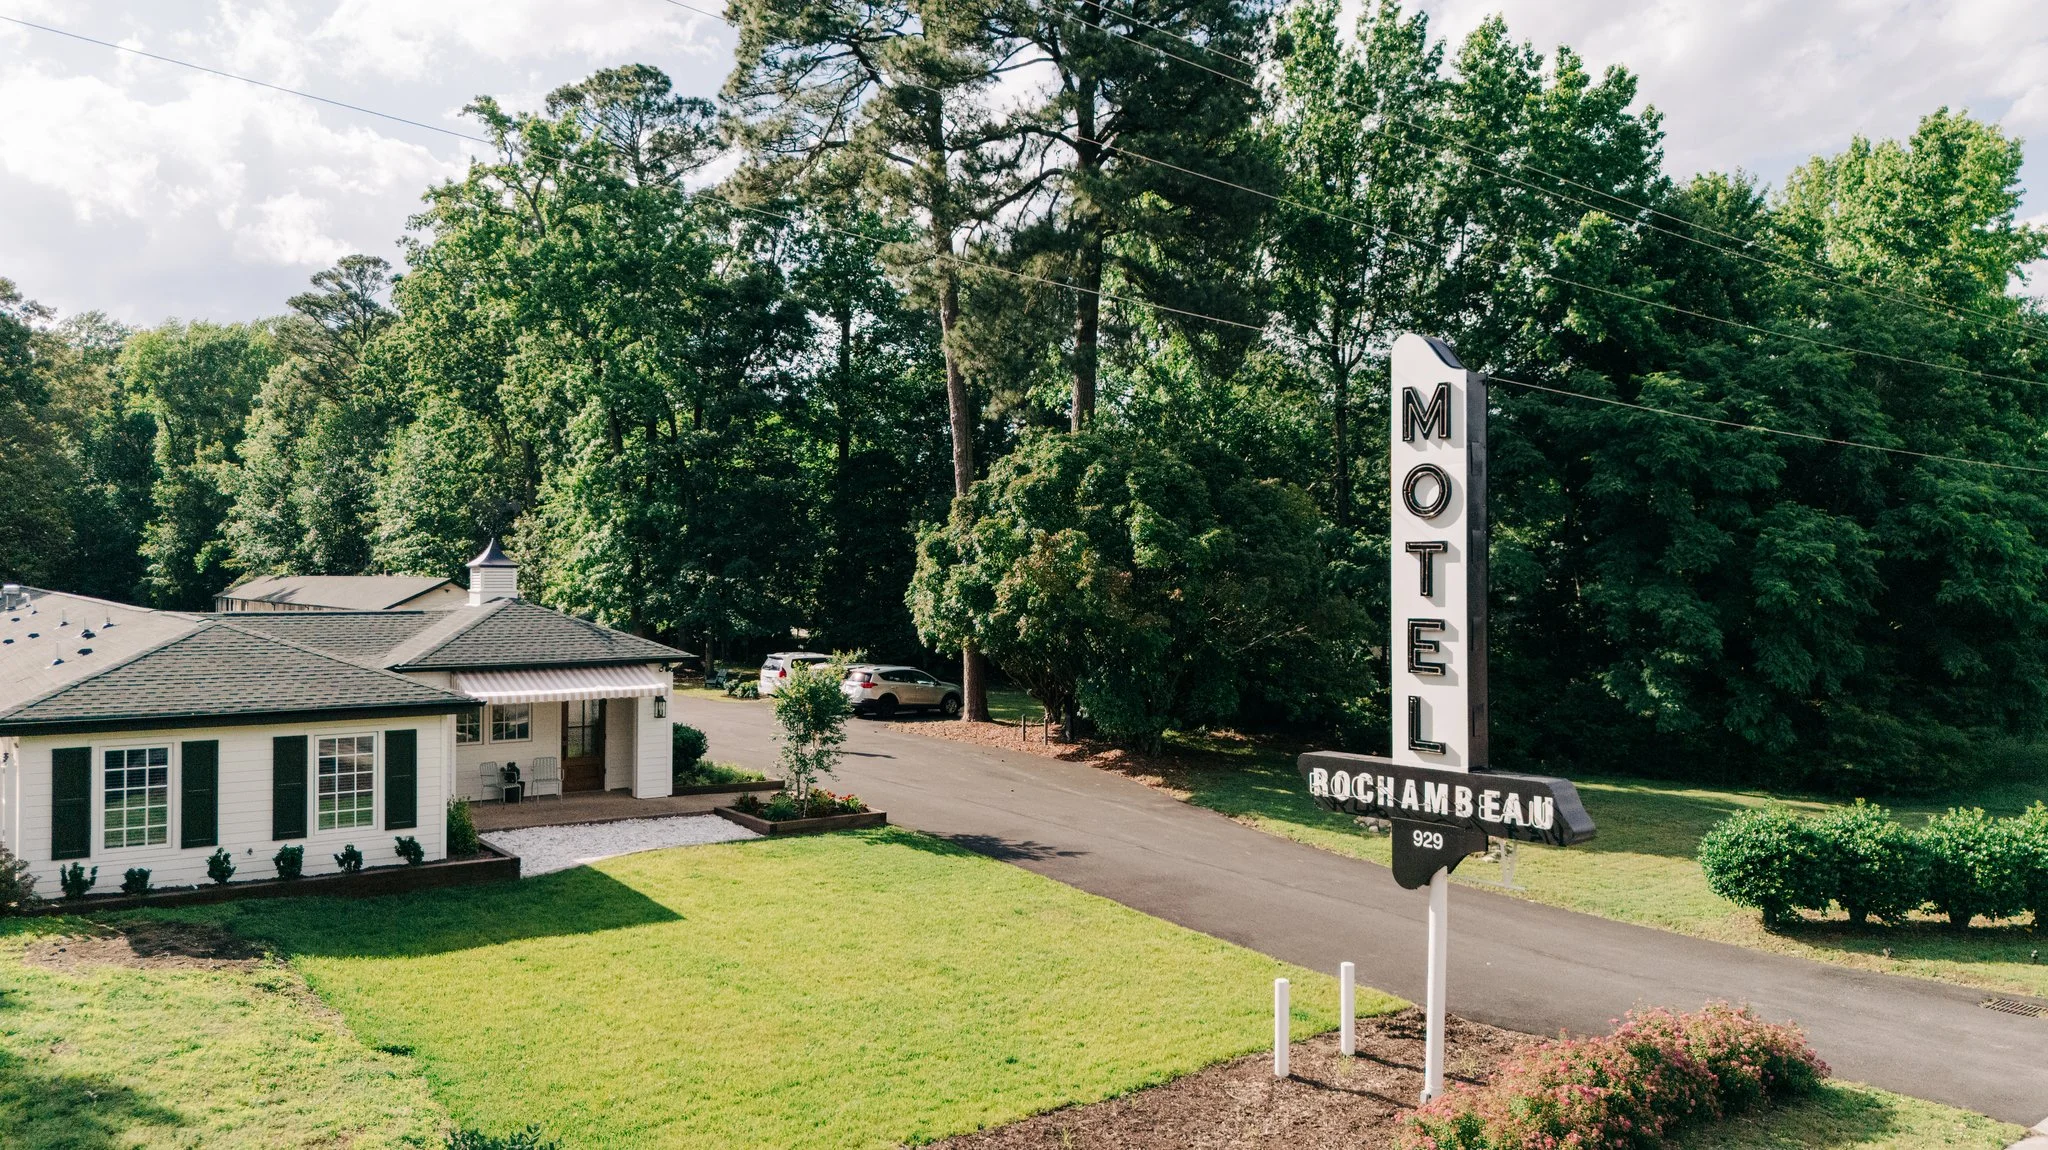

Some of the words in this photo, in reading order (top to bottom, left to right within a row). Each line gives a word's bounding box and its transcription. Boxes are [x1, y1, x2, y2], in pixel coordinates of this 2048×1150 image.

[1402, 382, 1452, 755] MOTEL
[1309, 767, 1554, 830] ROCHAMBEAU
[1412, 829, 1444, 850] 929
